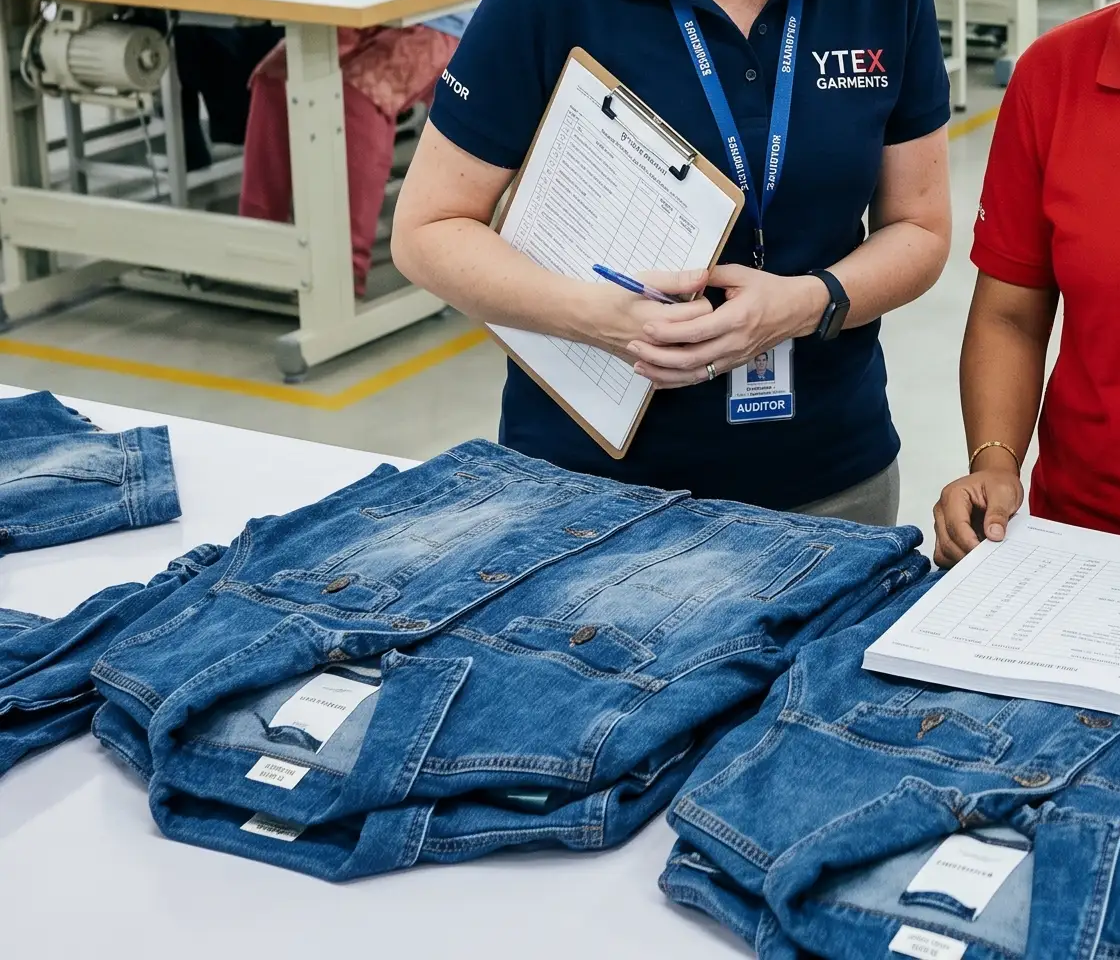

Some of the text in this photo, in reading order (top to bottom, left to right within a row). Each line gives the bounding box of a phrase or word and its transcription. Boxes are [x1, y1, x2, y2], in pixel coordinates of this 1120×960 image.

[811, 49, 886, 75] YTEX
[816, 75, 889, 90] GARMENTS
[736, 399, 786, 413] AUDITOR
